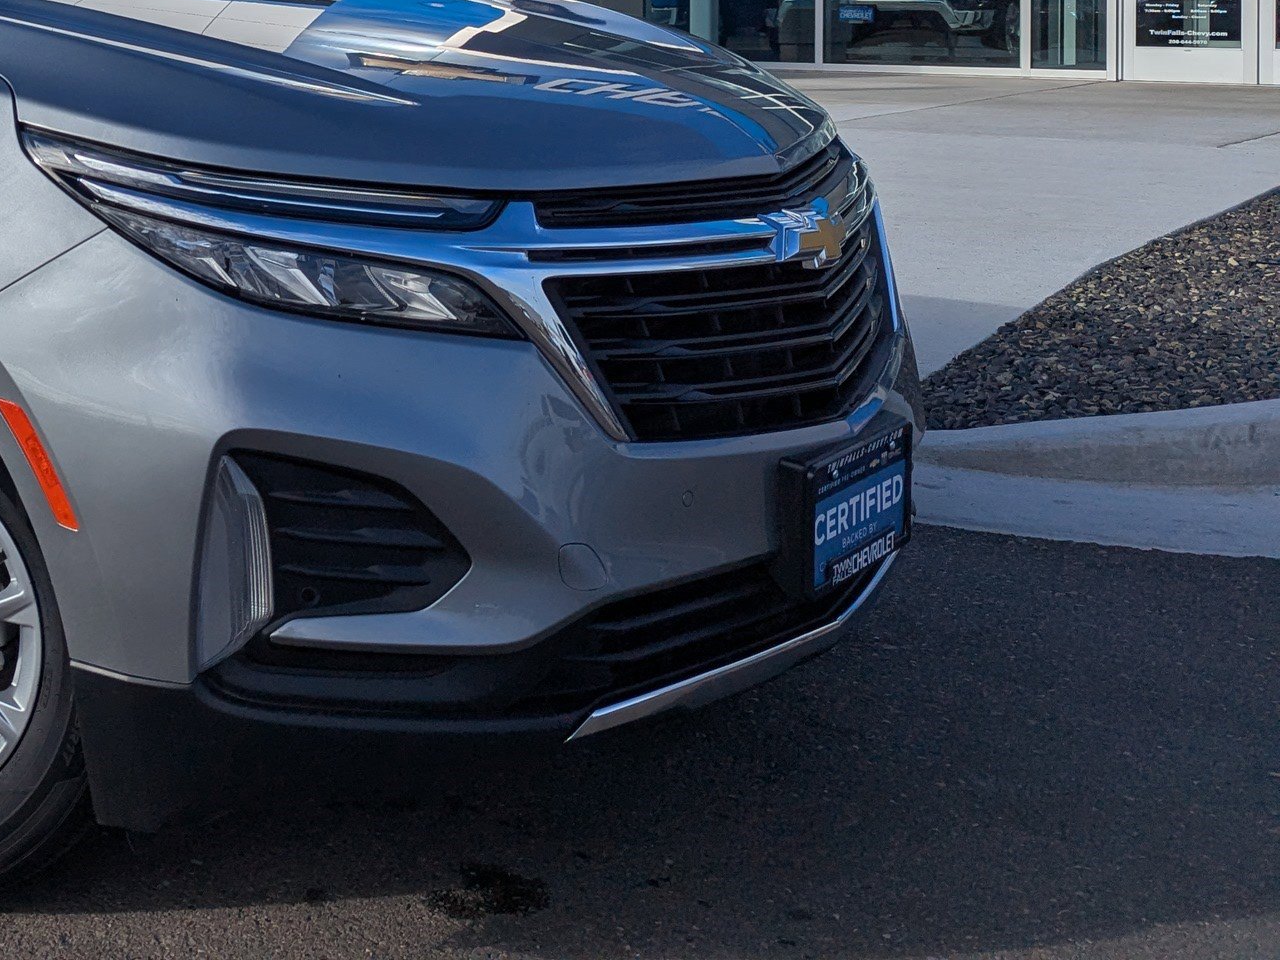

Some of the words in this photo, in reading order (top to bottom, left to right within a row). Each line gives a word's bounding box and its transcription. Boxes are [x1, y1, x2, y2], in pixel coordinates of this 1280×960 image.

[814, 474, 903, 546] CERTIFIED
[842, 526, 868, 548] BACKED
[868, 521, 878, 534] BY
[852, 531, 895, 573] CHEVROLET
[832, 566, 853, 586] FALLS
[833, 556, 853, 577] TWIN
